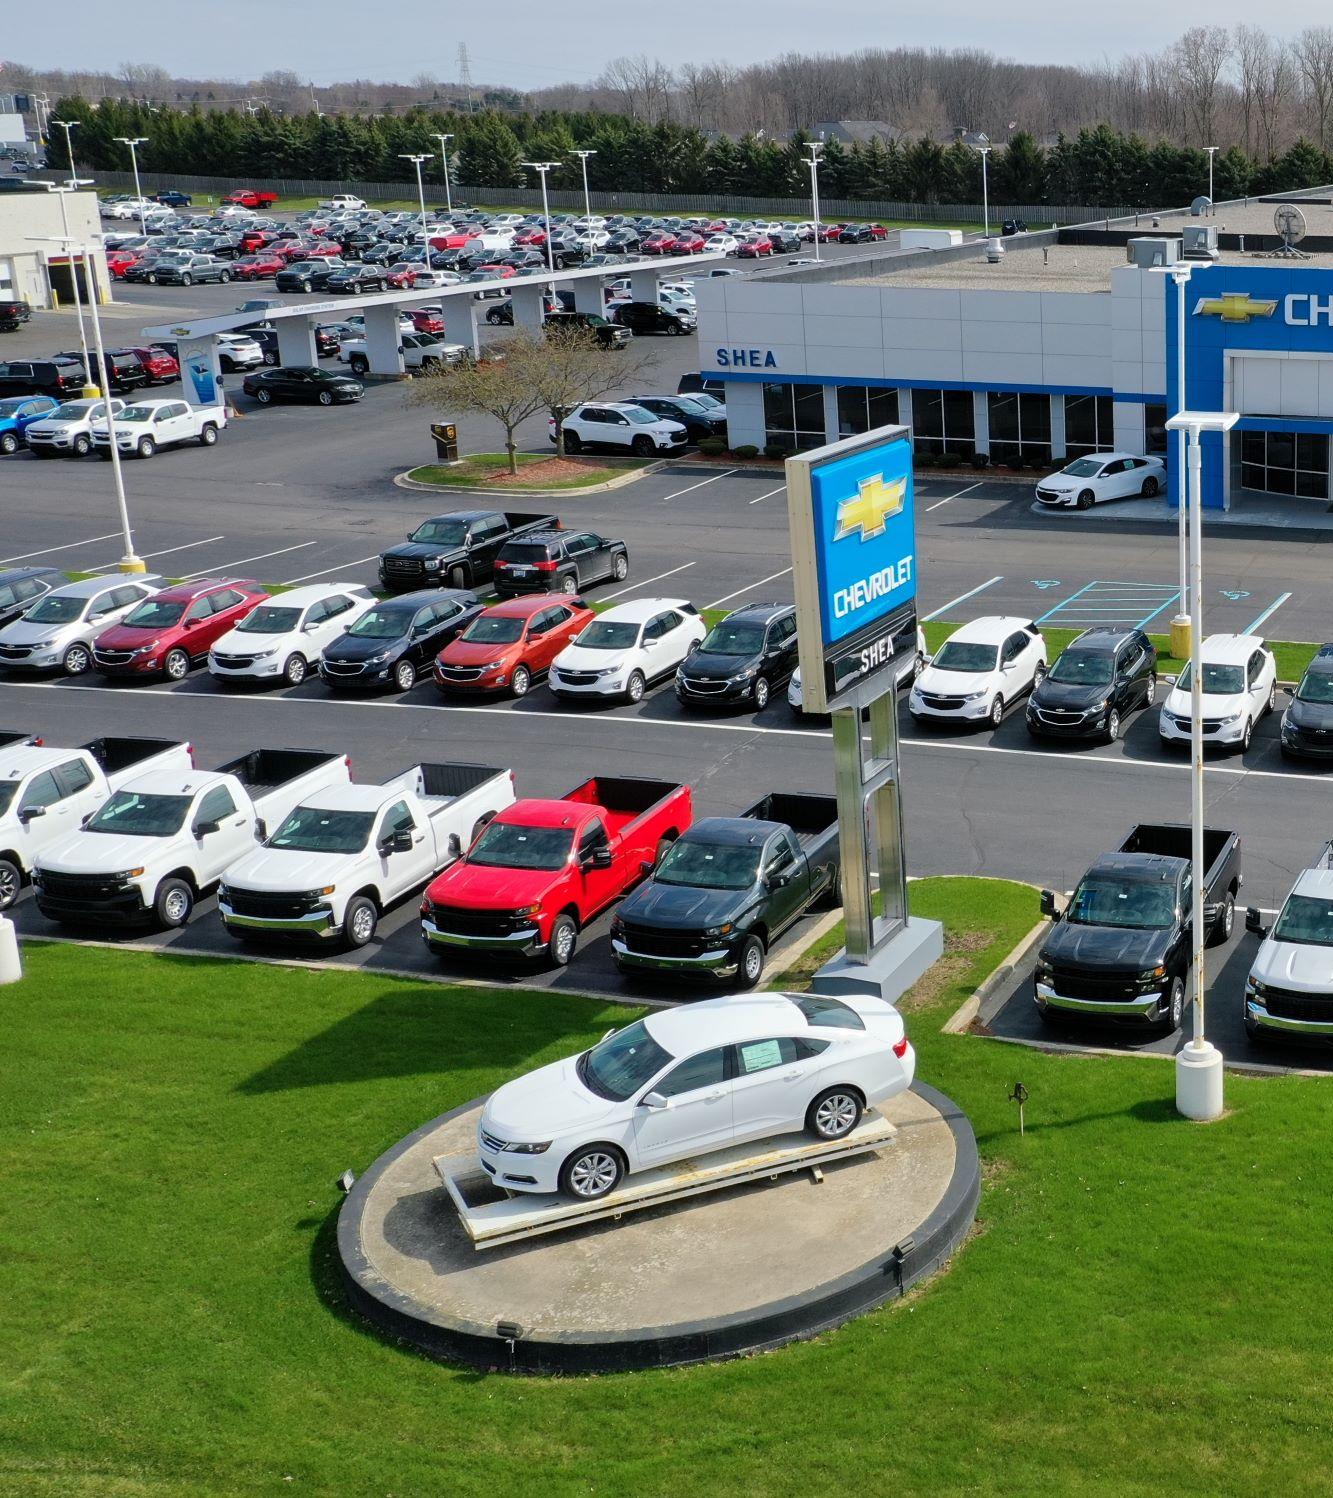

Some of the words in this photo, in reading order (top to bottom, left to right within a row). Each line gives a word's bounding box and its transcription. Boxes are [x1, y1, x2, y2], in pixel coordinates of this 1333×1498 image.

[716, 348, 777, 368] SHEA
[834, 555, 913, 618] CHEVROLET
[861, 636, 894, 673] SHEA
